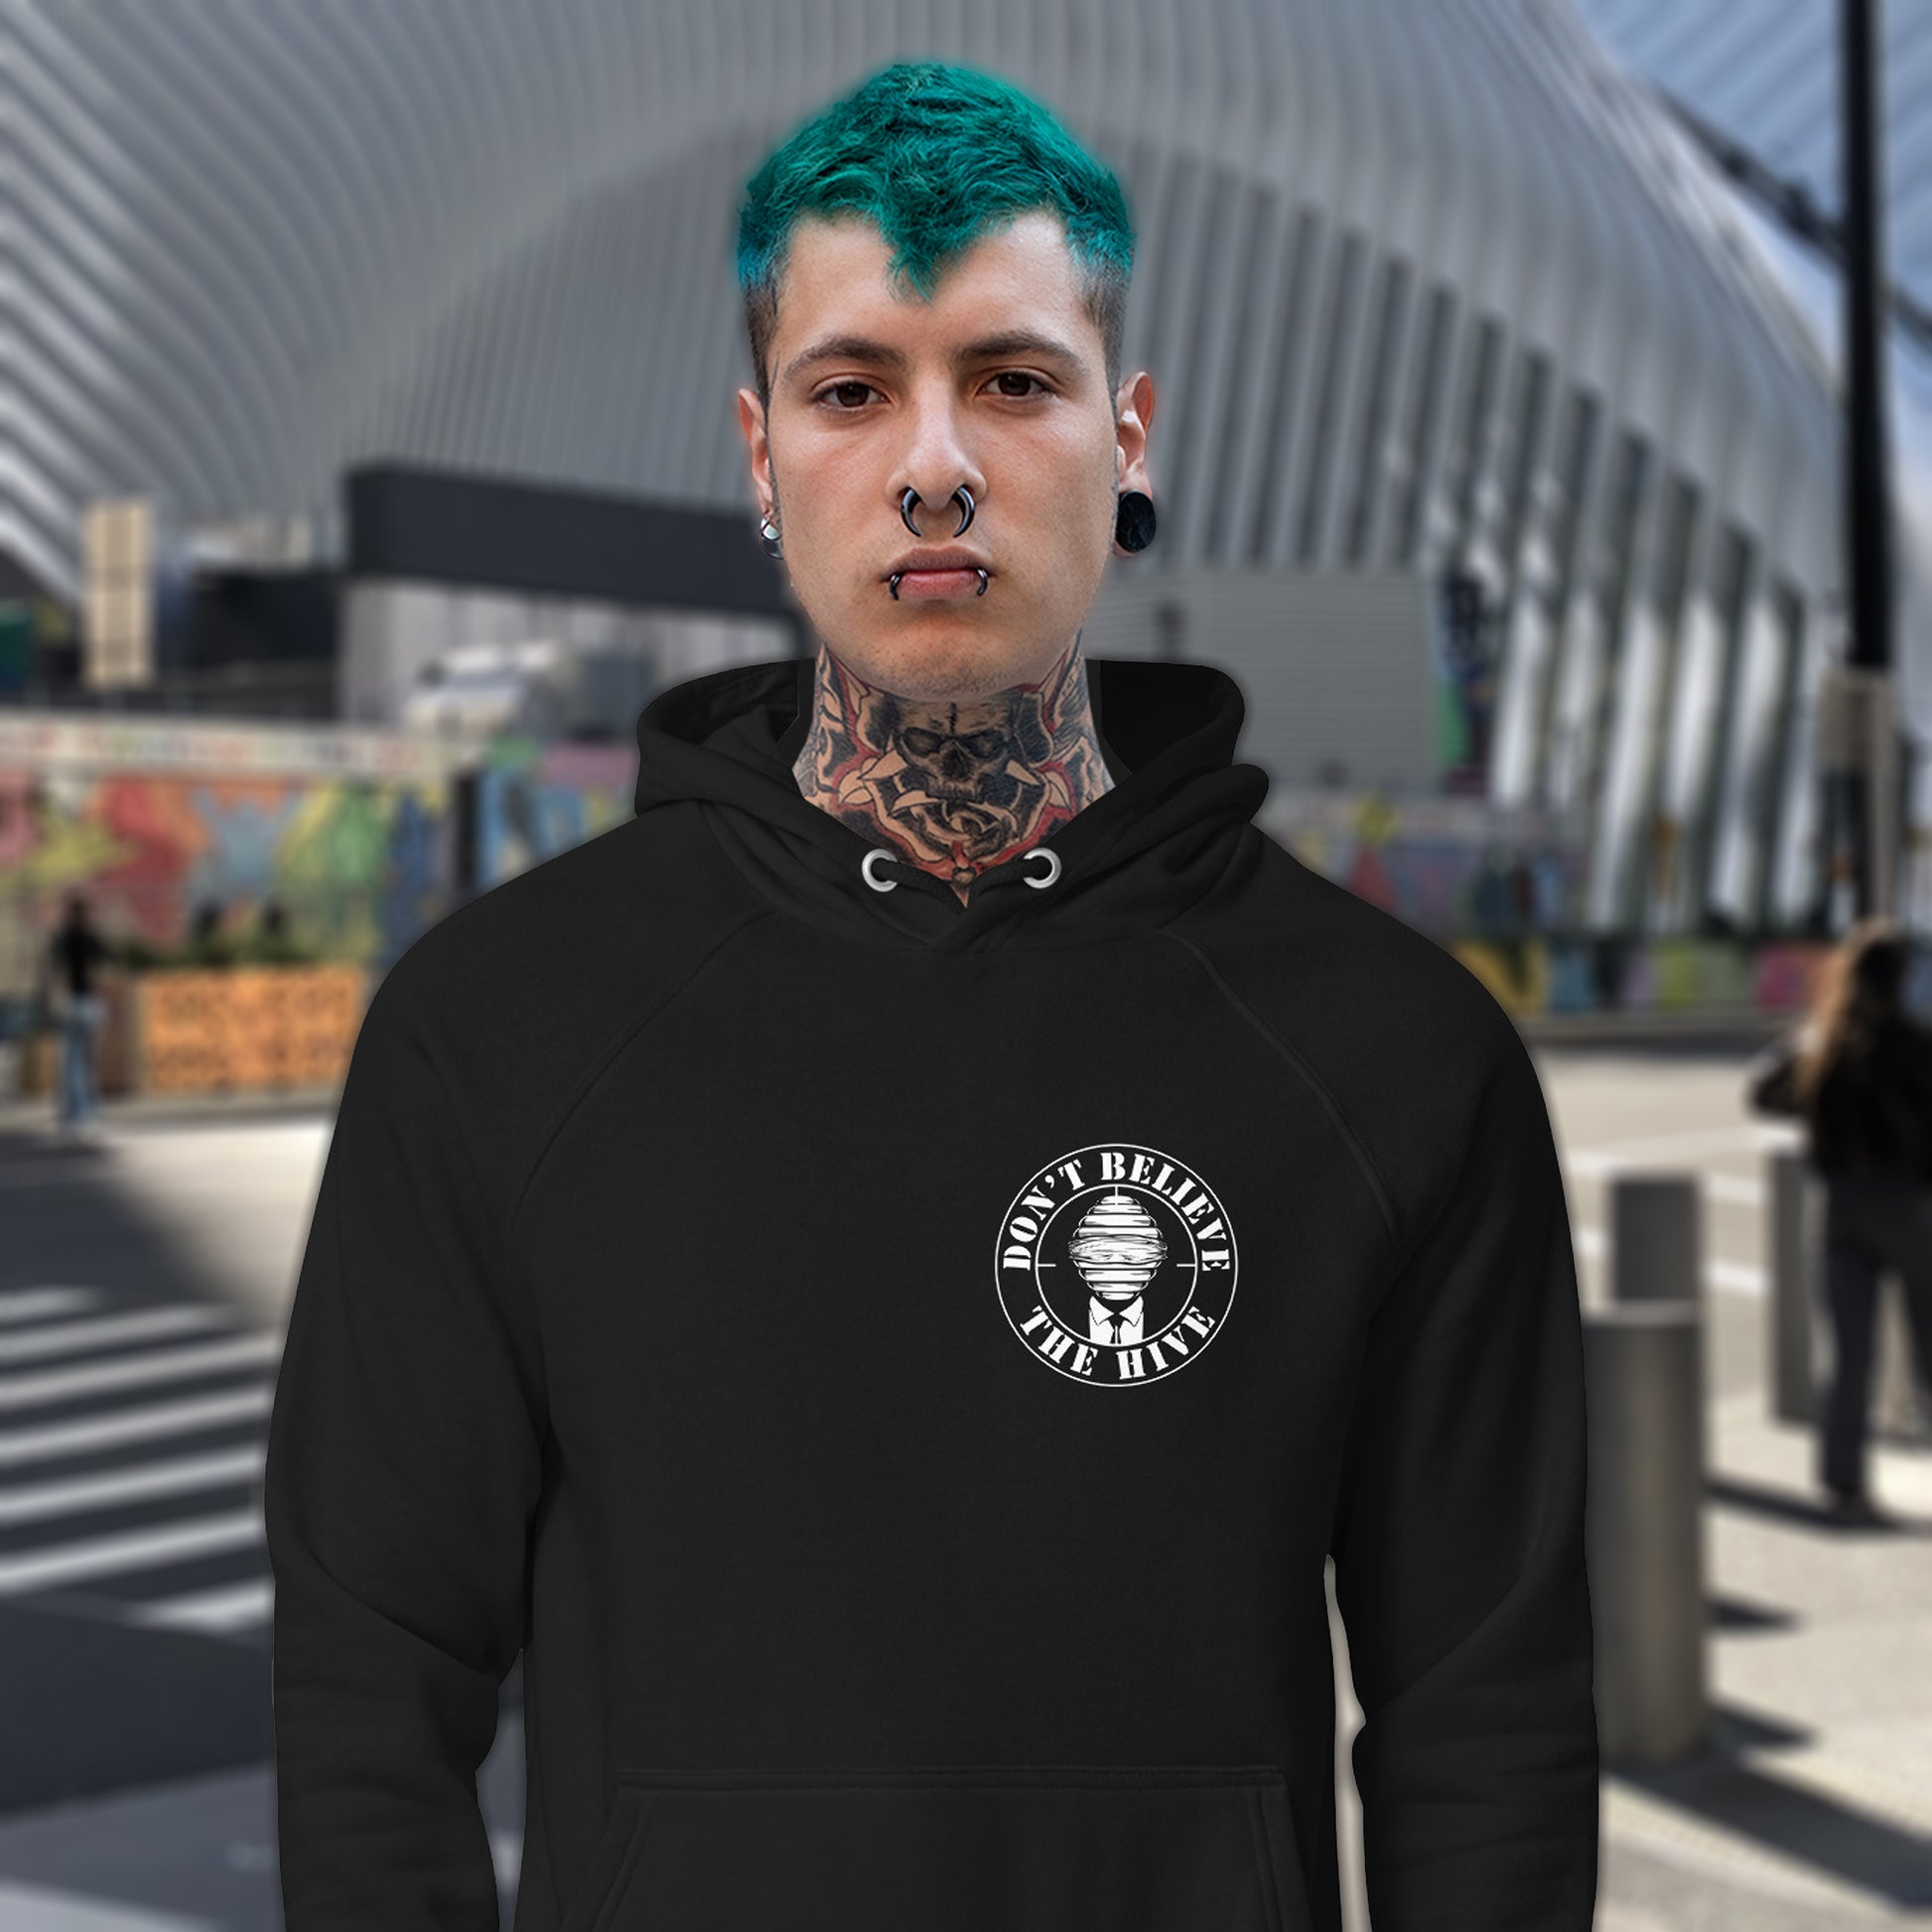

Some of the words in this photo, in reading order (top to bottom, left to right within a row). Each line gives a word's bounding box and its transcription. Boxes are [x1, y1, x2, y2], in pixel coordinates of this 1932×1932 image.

[1003, 1159, 1085, 1271] DON'T
[1100, 1152, 1230, 1272] BELIEVE
[1020, 1305, 1098, 1376] THE
[1116, 1306, 1216, 1380] HIVE
